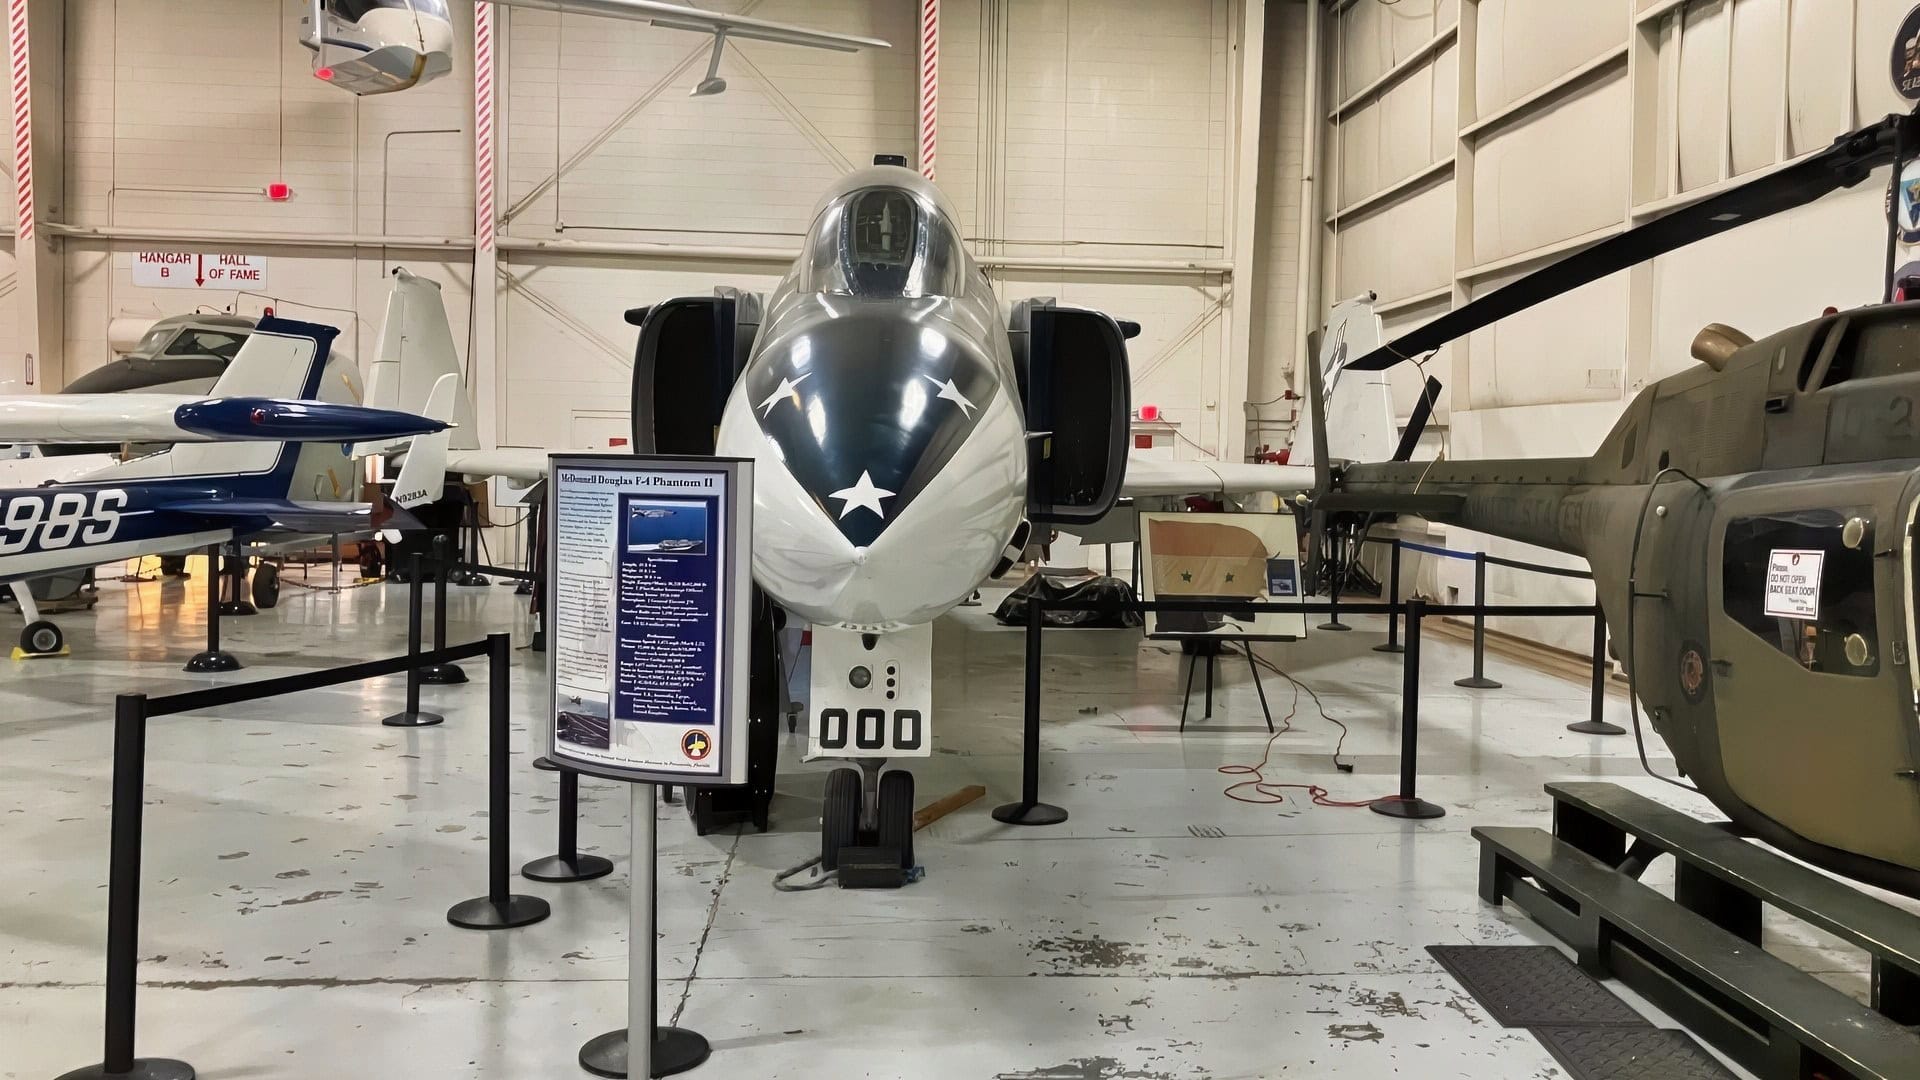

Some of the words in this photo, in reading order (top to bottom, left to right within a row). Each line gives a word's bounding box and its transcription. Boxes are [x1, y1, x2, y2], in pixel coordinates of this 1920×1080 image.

[140, 252, 191, 264] HANGAR
[219, 254, 250, 266] HALL
[161, 267, 170, 277] B
[209, 268, 225, 279] OF
[230, 269, 260, 280] FAME
[598, 475, 633, 487] Douglas
[653, 476, 701, 488] Phantom
[0, 488, 128, 555] 98S
[1771, 574, 1779, 583] DO
[1780, 574, 1790, 583] NOT
[1791, 575, 1807, 584] OPEN
[1769, 584, 1784, 594] BACK
[819, 708, 922, 750] 000
